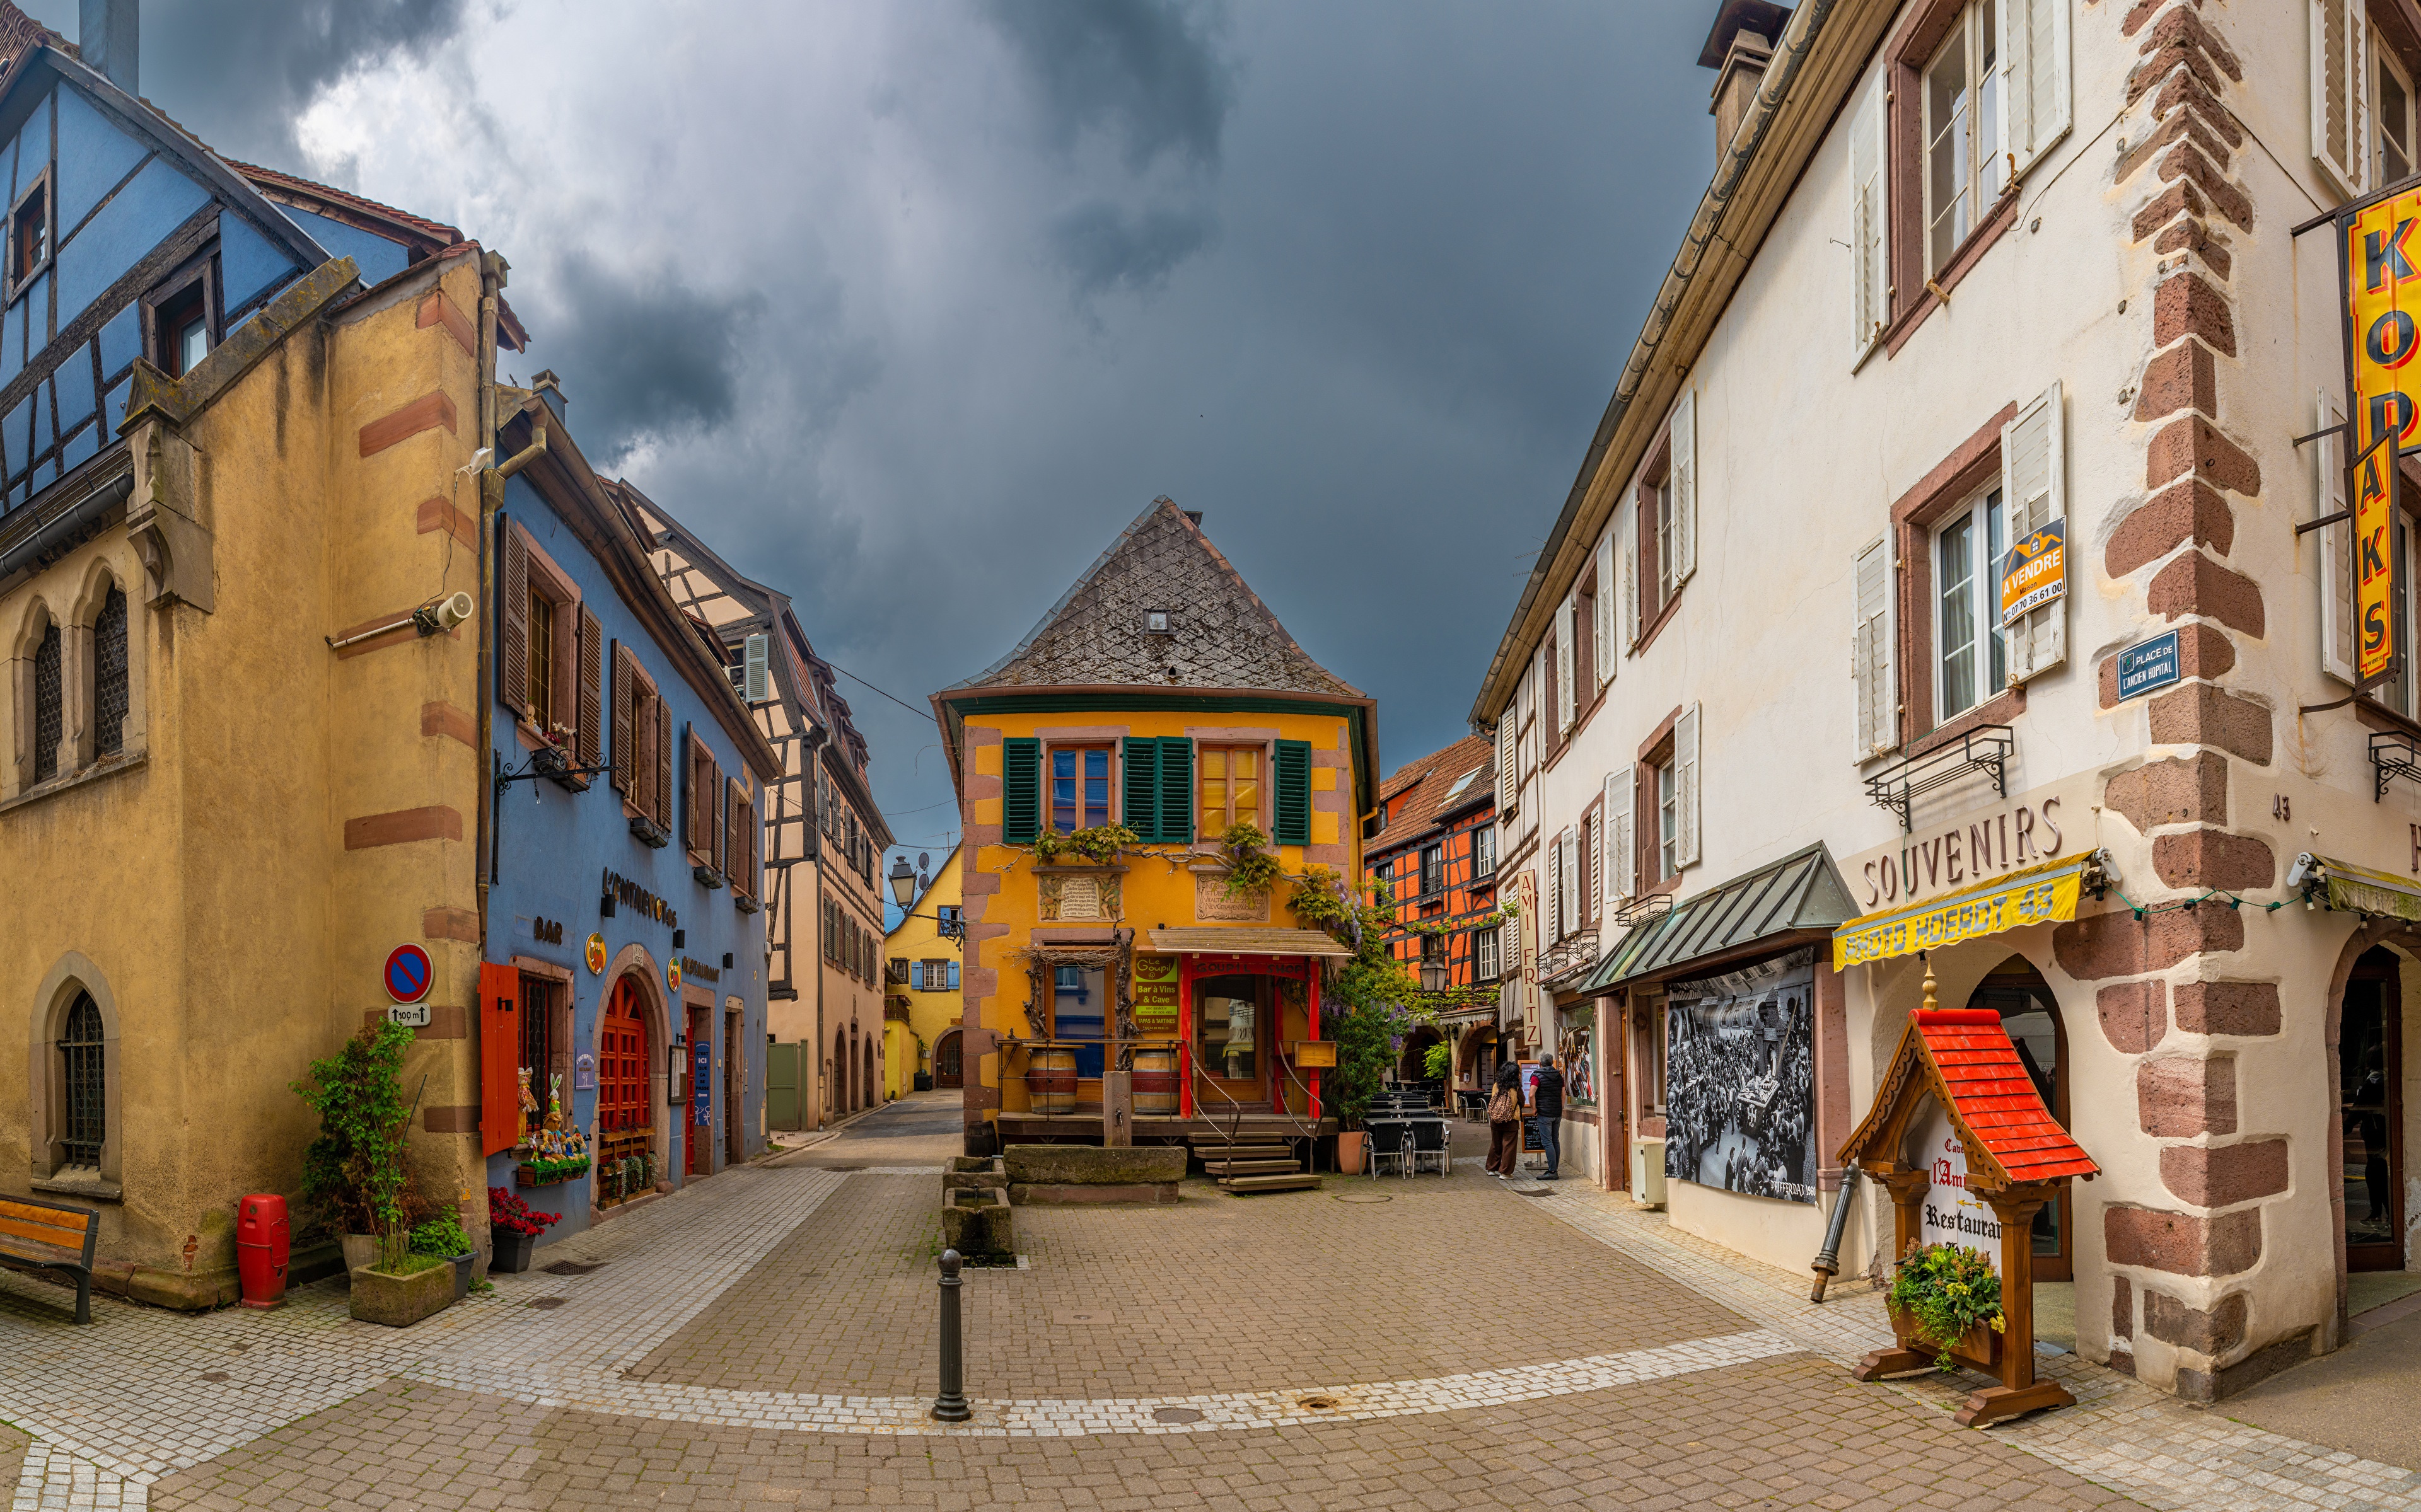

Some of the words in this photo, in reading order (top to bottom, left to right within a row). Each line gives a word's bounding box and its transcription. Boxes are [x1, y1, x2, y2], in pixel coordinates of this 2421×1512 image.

[2004, 580, 2010, 597] A
[2012, 550, 2060, 589] VENDRE
[2019, 581, 2037, 595] Maison
[2012, 605, 2019, 616] 07
[2019, 599, 2027, 611] 70
[2029, 593, 2038, 606] 36
[2040, 588, 2049, 599] 61
[2052, 582, 2062, 594] 00
[2136, 647, 2162, 666] PLACE
[2163, 645, 2173, 655] DE
[2371, 657, 2379, 665] VENTE
[2123, 670, 2146, 690] L'ANCIEN
[2148, 661, 2173, 680] HOPITAL
[2273, 792, 2290, 821] 43
[1864, 795, 2063, 907] SOUVENIRS
[535, 916, 562, 945] BAR
[1845, 922, 1907, 961] PHOTO
[1914, 895, 2008, 947] HOERDT
[2019, 882, 2054, 920] 43
[682, 956, 720, 983] RESTAURANT
[1137, 959, 1171, 974] Goupil
[1266, 964, 1303, 973] SHOP
[1524, 948, 1537, 1042] FRITZ
